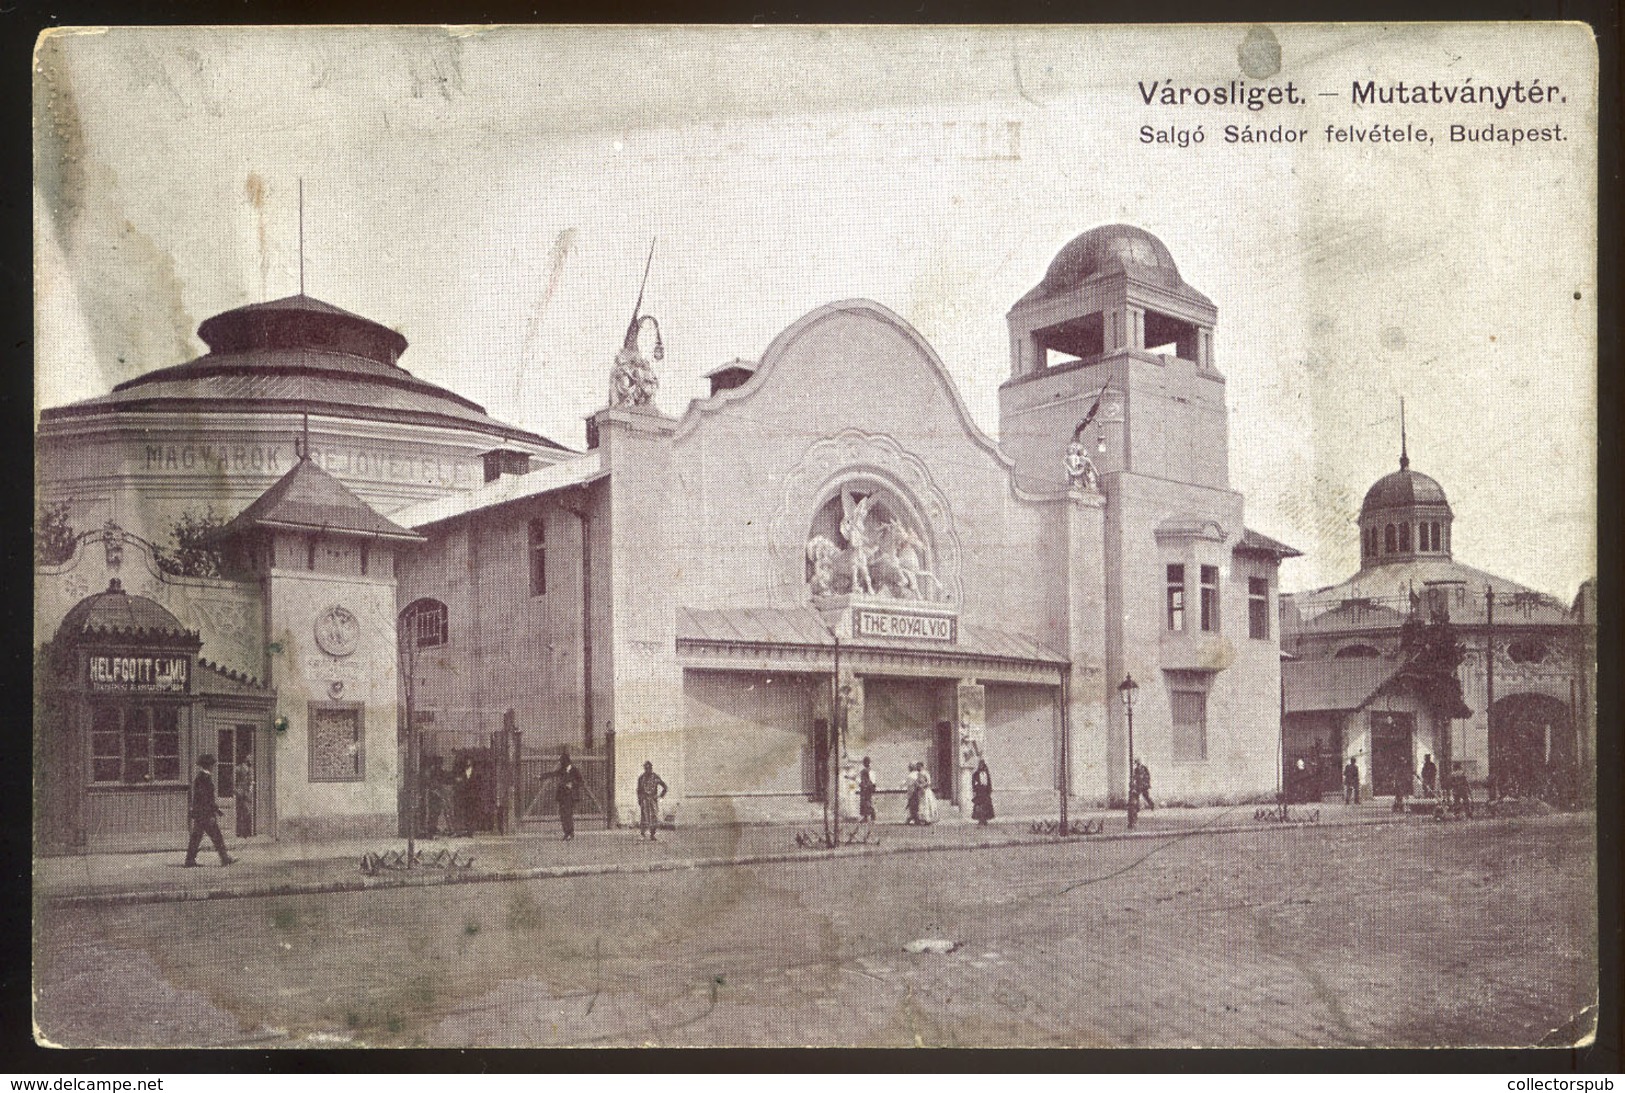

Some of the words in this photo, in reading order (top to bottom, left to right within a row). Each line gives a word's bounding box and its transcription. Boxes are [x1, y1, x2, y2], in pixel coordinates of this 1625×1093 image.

[146, 445, 280, 471] MAGYAROK
[864, 614, 887, 632] THE
[90, 657, 153, 683] HELFGOTT
